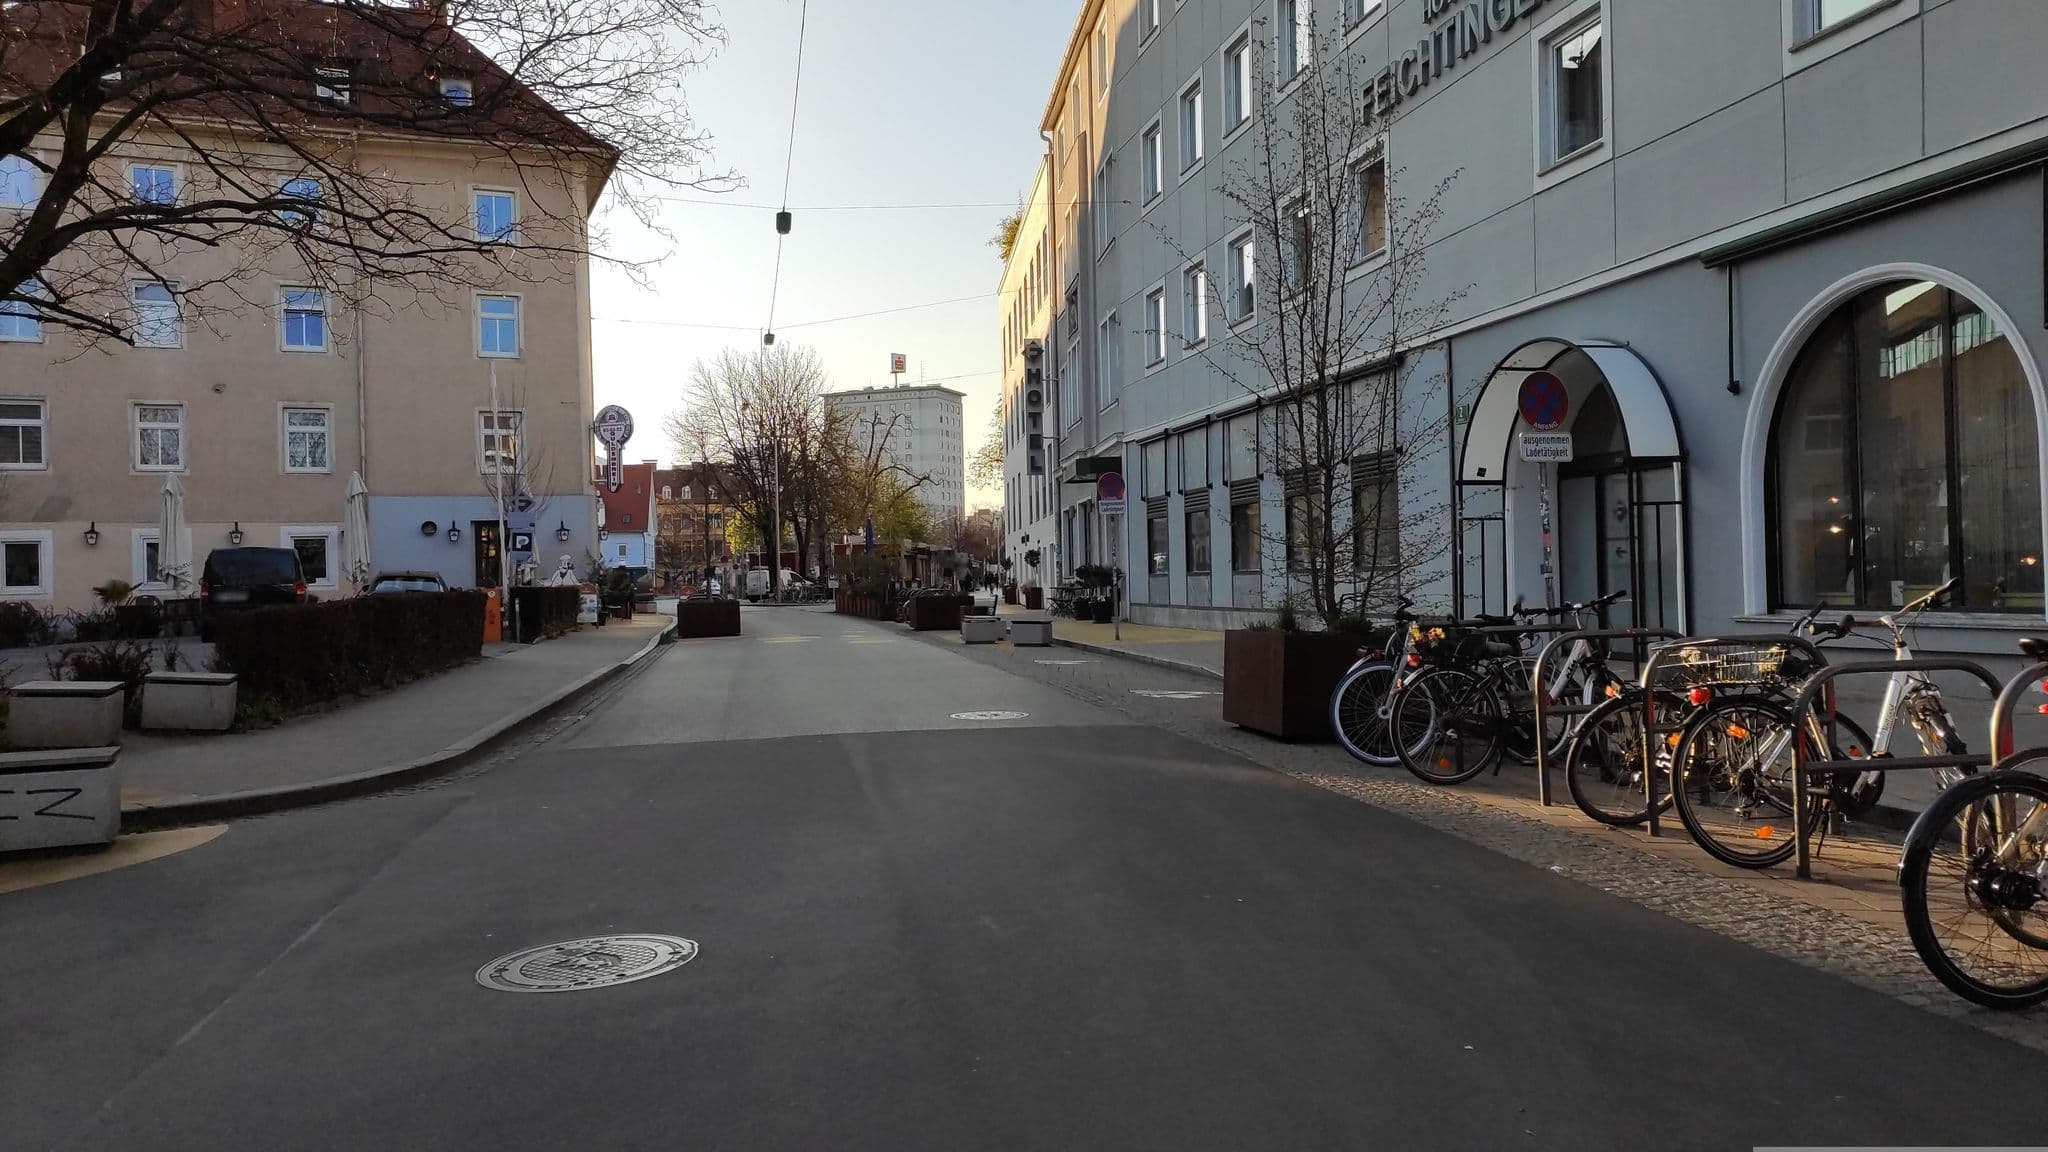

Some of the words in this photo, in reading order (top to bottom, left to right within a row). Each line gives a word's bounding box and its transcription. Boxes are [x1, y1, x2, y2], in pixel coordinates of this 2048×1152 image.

[1027, 368, 1042, 472] HOTEL
[1523, 436, 1570, 447] ausgenommen
[1525, 447, 1569, 459] Ladetätigkeit
[516, 535, 530, 549] P
